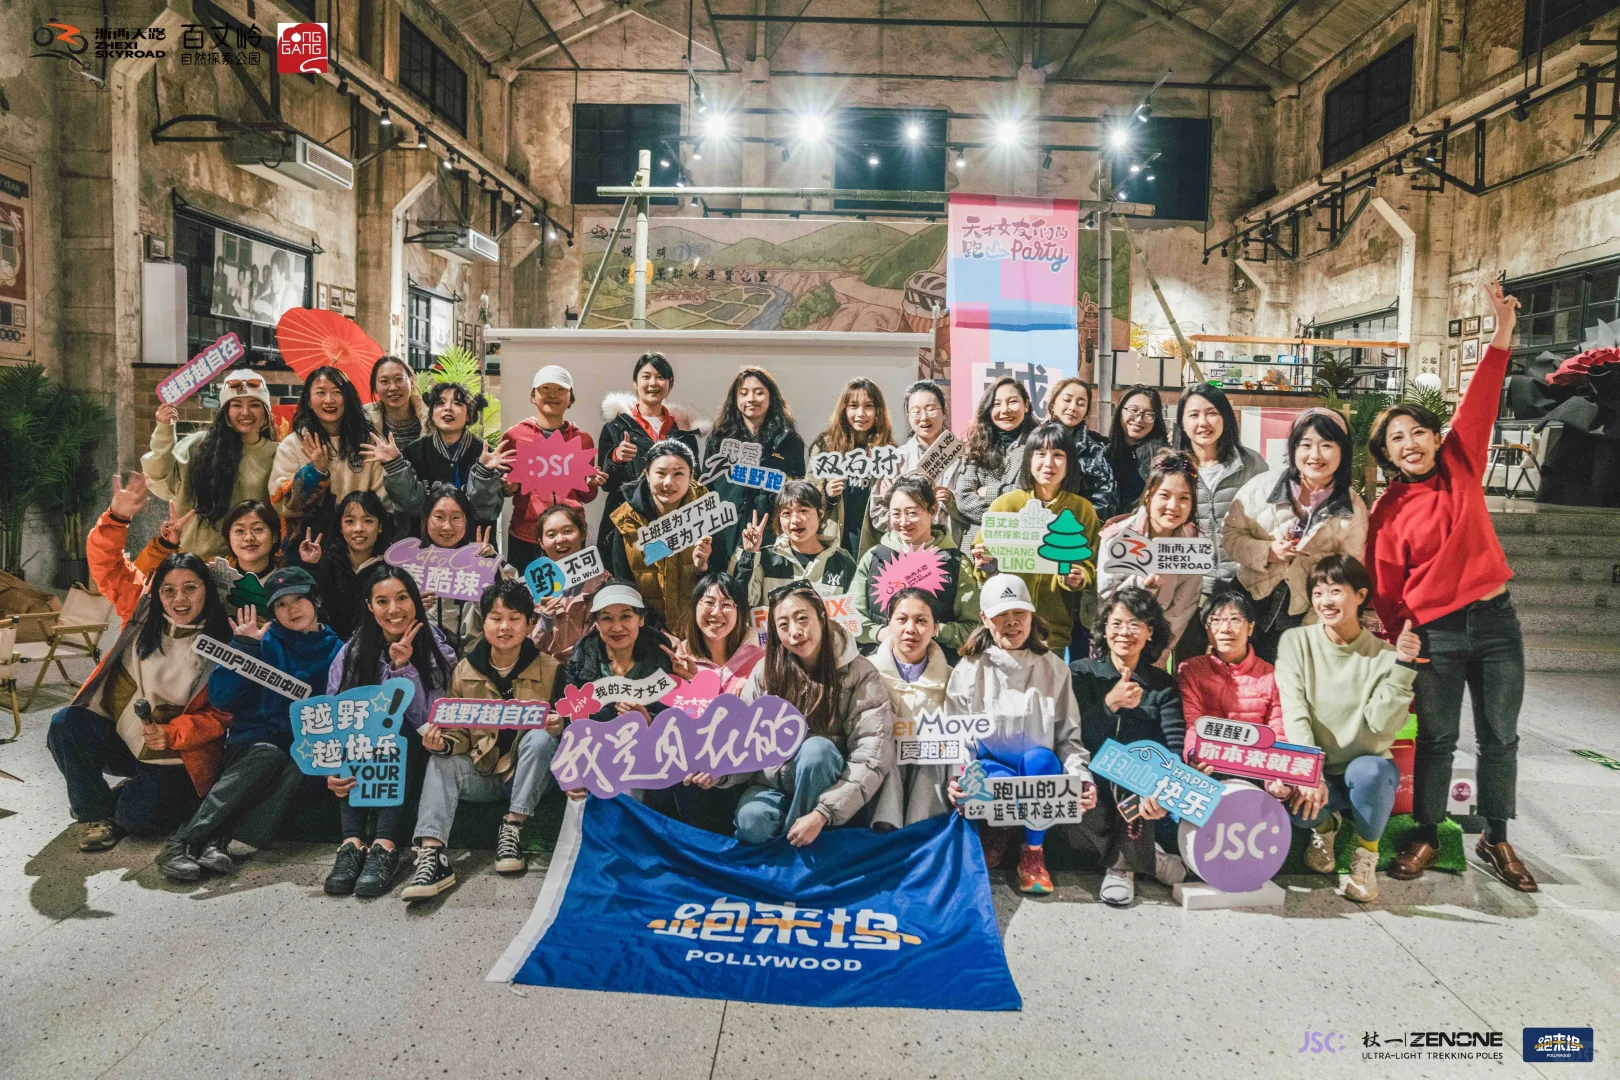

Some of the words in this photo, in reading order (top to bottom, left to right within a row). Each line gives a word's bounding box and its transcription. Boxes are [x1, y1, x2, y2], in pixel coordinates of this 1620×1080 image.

[962, 216, 1068, 240] 天才女友们的
[1010, 238, 1069, 273] Party
[160, 336, 241, 404] 越野越自在
[816, 448, 898, 476] 双石村
[928, 452, 948, 476] ZHEXI
[931, 444, 963, 480] SKYROAD
[731, 464, 783, 491] 越野跑
[640, 495, 717, 546] 上班是为了下班
[665, 507, 735, 551] 更为了上山
[985, 516, 1020, 529] 百丈岭
[984, 529, 1040, 541] 自然探索公园
[564, 549, 597, 576] 不可
[983, 545, 1035, 557] BAIZHANG
[571, 576, 582, 584] Go
[582, 567, 600, 579] Wrid
[1002, 556, 1036, 571] LING
[595, 677, 671, 699] 我的天才女友
[300, 700, 370, 736] 越野
[433, 703, 545, 725] 越野越自在
[311, 733, 397, 768] 越快乐
[901, 740, 960, 761] 爱跑猫
[1198, 742, 1314, 777] 你本来就美
[349, 765, 400, 780] YOUR
[1171, 767, 1219, 795] HAPPY
[361, 783, 398, 799] LIFE
[993, 780, 1078, 800] 跑山的人
[1153, 776, 1212, 820] 快乐
[993, 802, 1078, 821] 运气都不会太差
[646, 896, 922, 951] 跑来坞
[685, 949, 862, 971] POLLYWOOD
